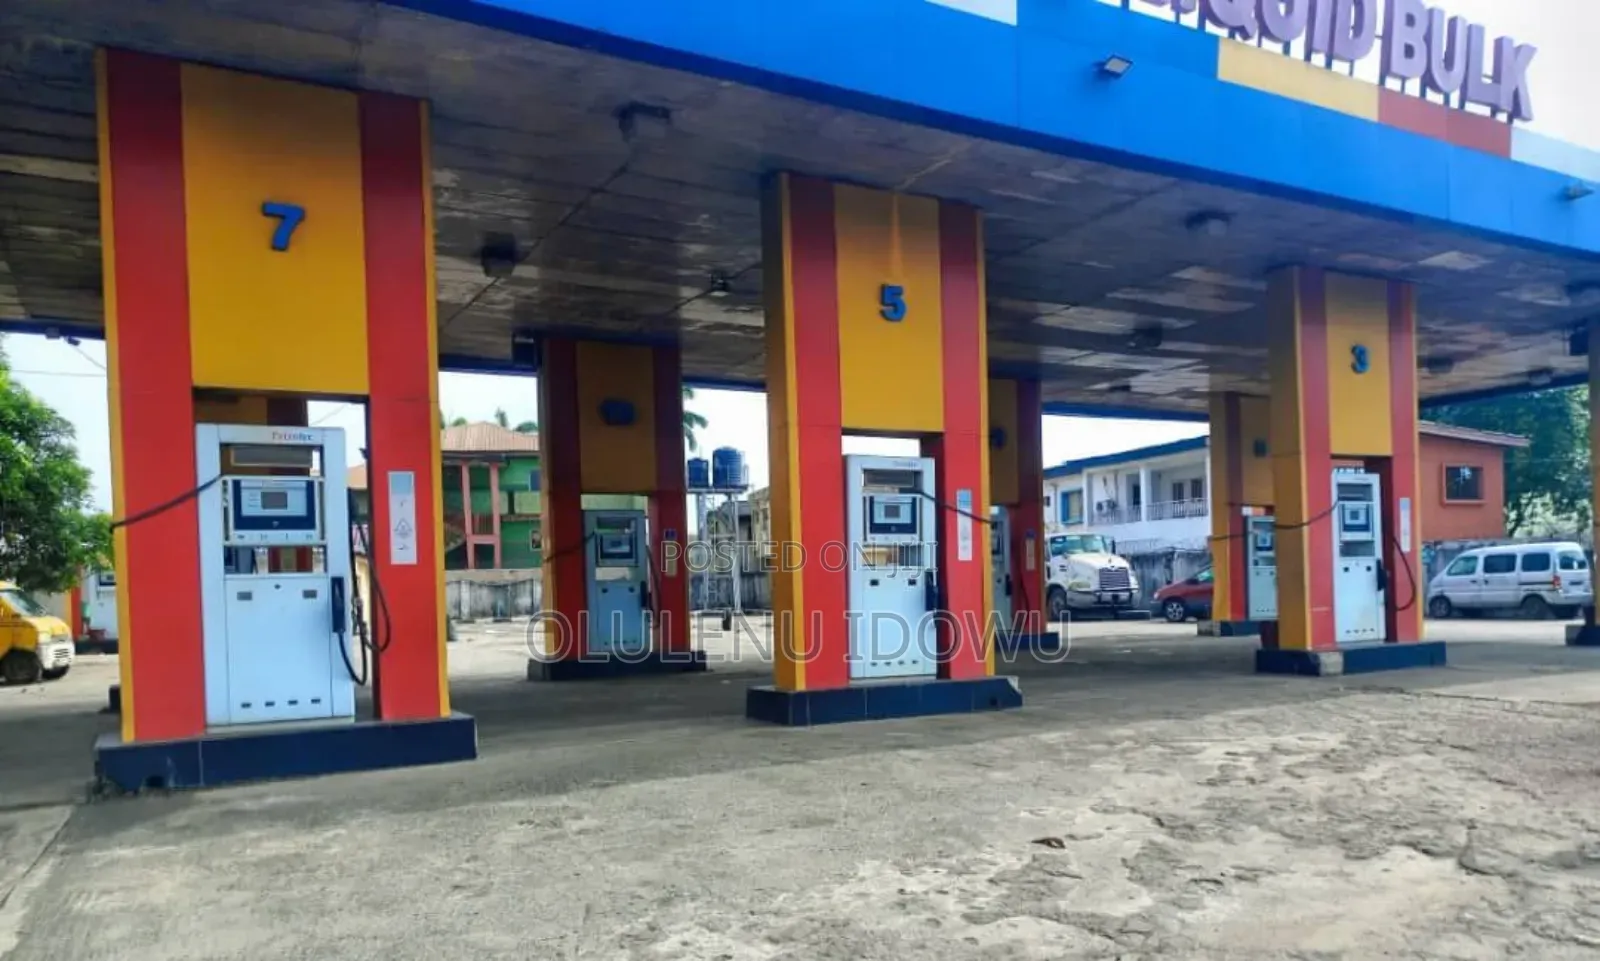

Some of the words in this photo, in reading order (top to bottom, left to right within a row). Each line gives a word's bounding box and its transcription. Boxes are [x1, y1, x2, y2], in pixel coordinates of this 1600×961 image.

[1381, 0, 1537, 121] BULK
[260, 201, 306, 252] 7
[879, 283, 907, 323] 5
[1350, 344, 1369, 375] 3
